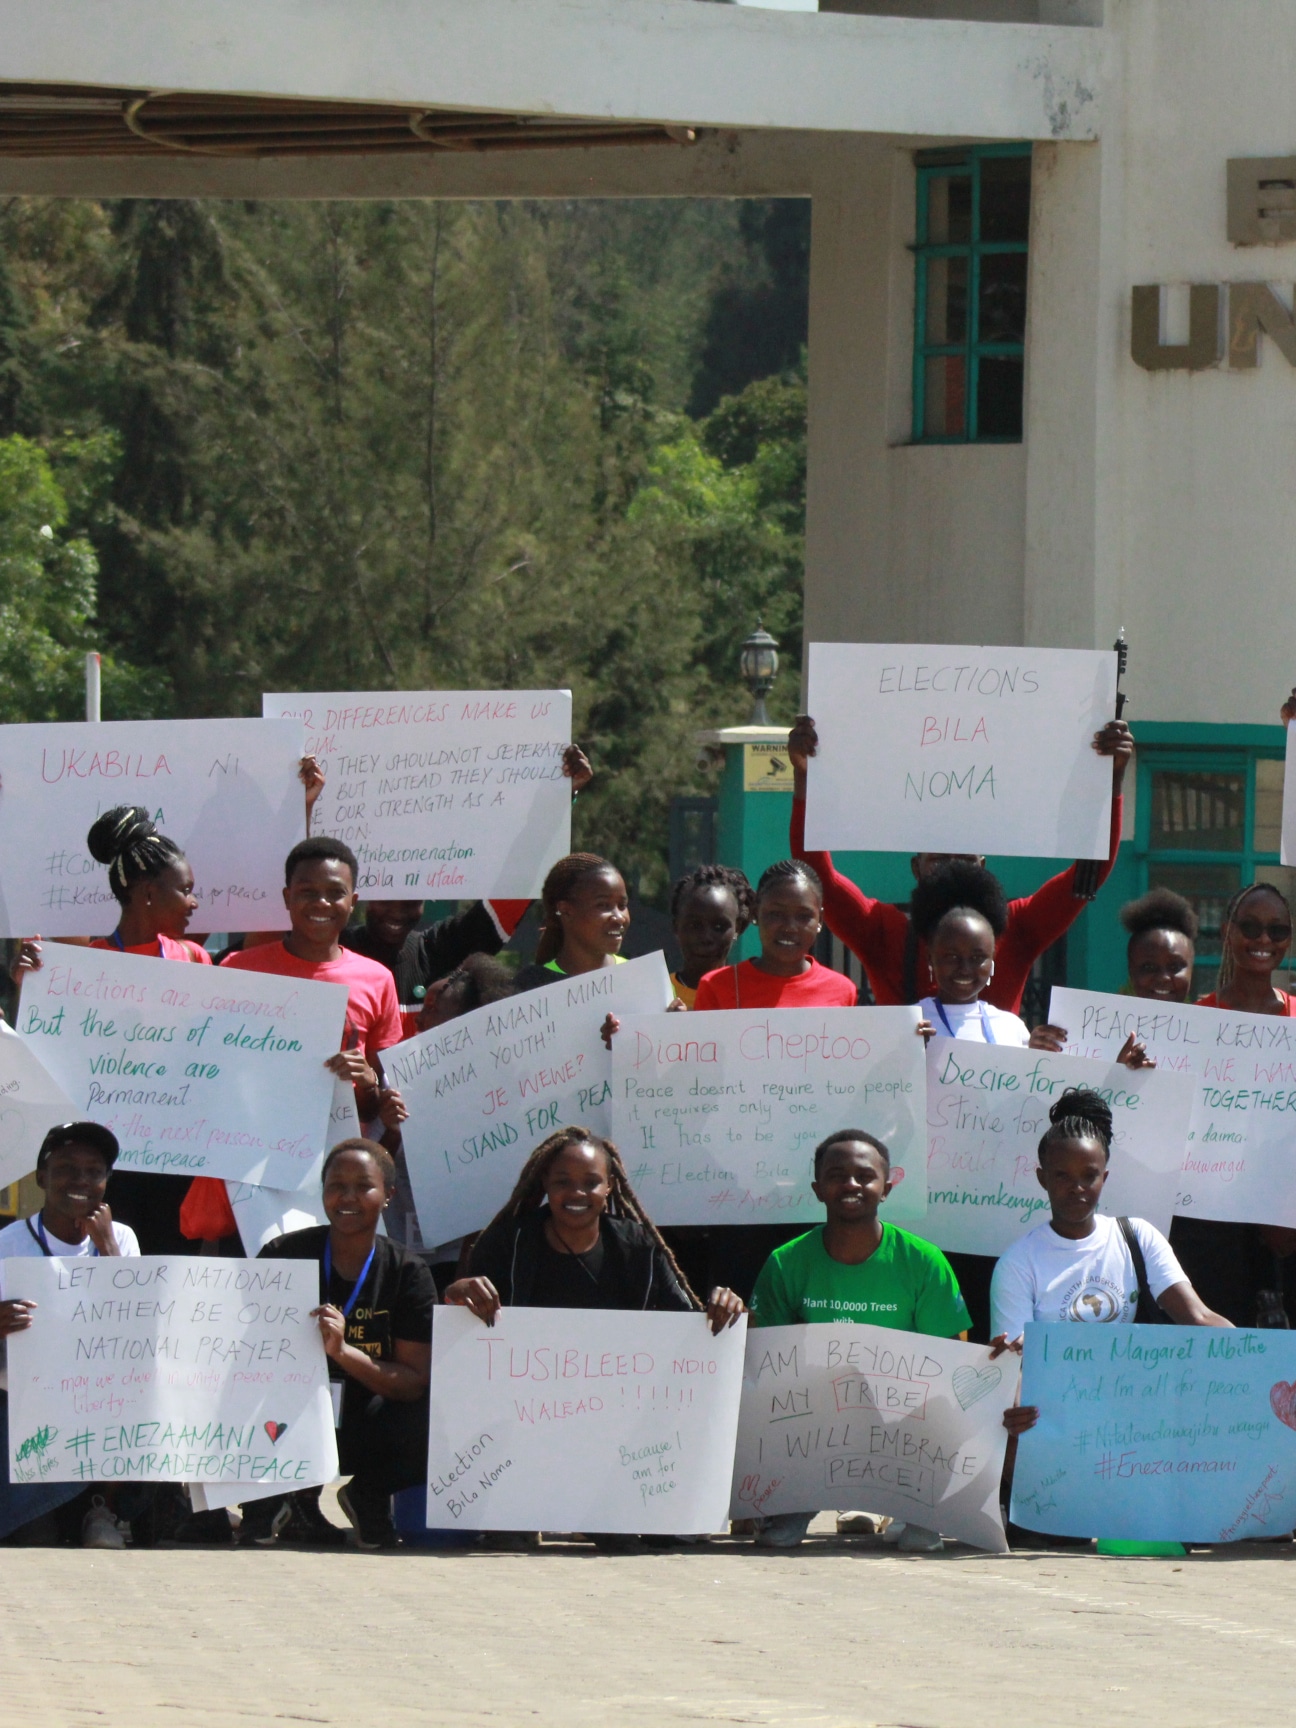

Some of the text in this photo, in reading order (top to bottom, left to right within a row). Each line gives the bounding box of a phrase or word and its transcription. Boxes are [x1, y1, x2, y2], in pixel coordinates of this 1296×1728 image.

[879, 665, 1040, 698] ELECTIONS
[322, 702, 449, 731] DIFFERENCES
[461, 701, 517, 722] MAKE
[531, 702, 552, 719] US
[920, 716, 990, 748] BILA
[41, 747, 240, 784] UKABILA NI
[751, 744, 789, 753] WARNIN
[336, 766, 491, 800] BUT INSTEAD THEY
[904, 764, 997, 802] NOMA
[335, 793, 455, 822] OUR STRENGTH
[46, 965, 148, 1004] Elections
[21, 1004, 303, 1052] But the scars of election
[391, 974, 614, 1087] NITAENEZA AMANI MIMI
[1080, 1005, 1200, 1044] PEACEFUL
[632, 1018, 871, 1073] Diana Cheptoo
[89, 1048, 221, 1080] violence are
[434, 1062, 478, 1098] KAMA
[938, 1052, 1066, 1095] Desire for
[1203, 1057, 1236, 1083] WE
[481, 1053, 585, 1116] JE WEWE?
[624, 1078, 913, 1104] Peace require two people
[738, 1101, 773, 1125] only
[927, 1094, 1044, 1135] Strive for
[457, 1100, 563, 1165] STAND FOR
[678, 1123, 712, 1148] has
[57, 1264, 295, 1293] LET OUR NATIONAL
[71, 1300, 301, 1326] ANTHEM BE OUR
[869, 1302, 898, 1312] Trees
[348, 1325, 365, 1339] ME
[74, 1335, 298, 1366] NATIONAL PRAYER
[477, 1338, 718, 1381] TUSIBLEED NDIO
[757, 1339, 943, 1381] AM BEYOND
[1062, 1345, 1094, 1362] am
[1109, 1332, 1194, 1370] Margaret
[771, 1380, 921, 1414] MY TRIBE
[1061, 1374, 1101, 1403] And
[1141, 1371, 1169, 1398] all
[72, 1452, 312, 1482] #COMRADEFORPEACE
[430, 1432, 494, 1497] Election
[618, 1441, 673, 1467] Because
[785, 1423, 978, 1477] WILL EMBRACE
[829, 1458, 924, 1493] PEACE!
[445, 1490, 479, 1519] Bila
